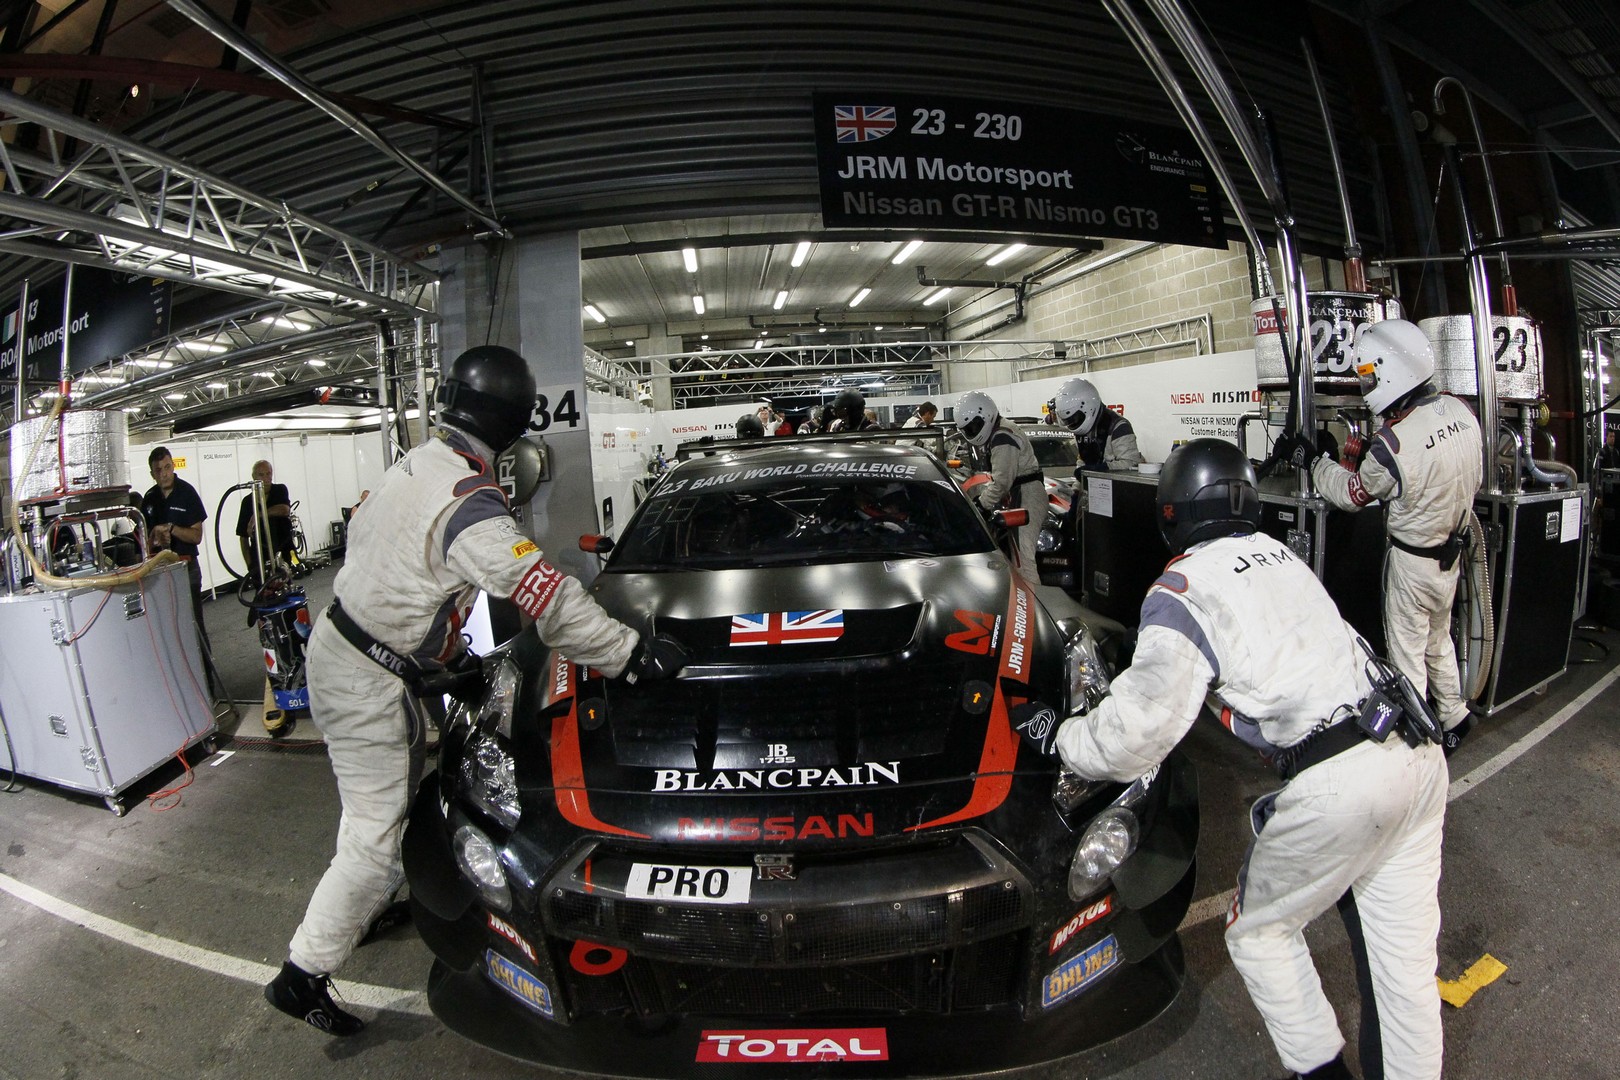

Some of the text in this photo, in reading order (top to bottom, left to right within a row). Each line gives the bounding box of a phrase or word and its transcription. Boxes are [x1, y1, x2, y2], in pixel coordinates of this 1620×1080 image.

[911, 108, 946, 136] 23
[973, 112, 1022, 141] 230
[838, 155, 1074, 190] JRM Motorsport
[1148, 151, 1202, 167] BLANCPAIN
[1150, 164, 1185, 176] ENDURANCE
[843, 191, 1160, 230] Nissan GT-R Nismo GT3
[28, 312, 89, 355] Motorsort
[1493, 326, 1528, 372] 23
[529, 390, 580, 431] 34
[1170, 393, 1204, 404] NISSAN
[672, 425, 707, 433] NISSAN
[1180, 417, 1200, 425] NISSAN
[1201, 417, 1214, 426] GT-R
[1215, 417, 1236, 426] NISMO
[1191, 427, 1238, 439] Customer Racing
[1425, 422, 1460, 449] JRM
[657, 462, 918, 497] 23 BAKU WORLD CHALLENGE
[1043, 557, 1068, 565] MOTUL
[1233, 549, 1293, 574] JRM
[1008, 588, 1027, 674] JRM-GROUP.COM
[651, 761, 900, 792] BLANCPAIN
[677, 813, 874, 842] NISSAN
[647, 867, 729, 899] PRO
[490, 913, 536, 961] MOTUL
[1053, 899, 1107, 950] MOTUL
[707, 1035, 881, 1057] TOTAL
